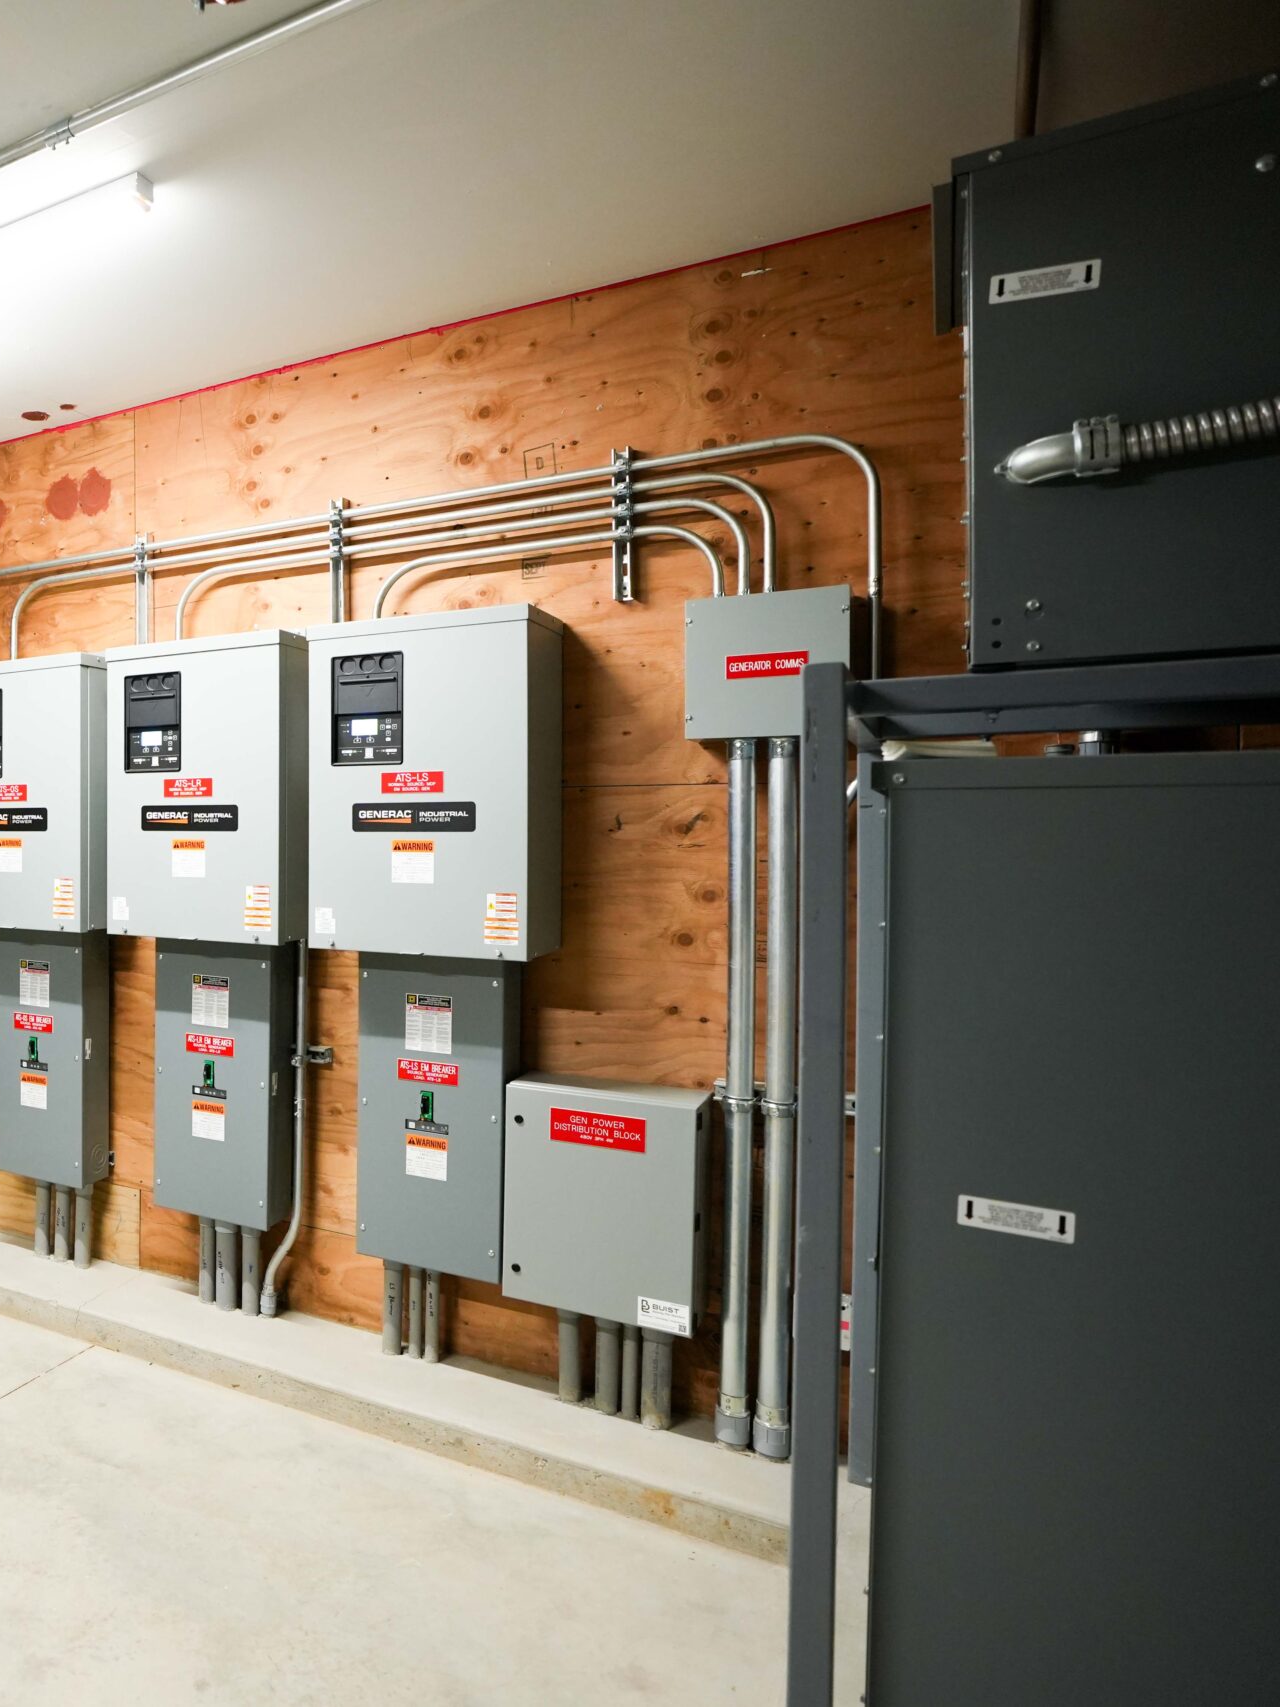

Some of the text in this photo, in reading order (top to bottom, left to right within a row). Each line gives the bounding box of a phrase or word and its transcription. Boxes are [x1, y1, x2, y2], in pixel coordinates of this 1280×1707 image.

[729, 658, 804, 672] GENERATOR COMMS
[396, 773, 428, 782] ATS-LS
[359, 810, 412, 818] GENERAC
[402, 843, 432, 851] WARNING
[213, 1038, 232, 1047] BREAKER
[400, 1060, 456, 1074] ATS-LS EM BREAKER
[200, 1104, 224, 1114] WARNING
[570, 1115, 624, 1129] GEN POWER
[554, 1122, 641, 1141] DISTRIBUTION BLOCK
[416, 1138, 446, 1150] WARNING
[652, 1304, 680, 1314] BUIST
